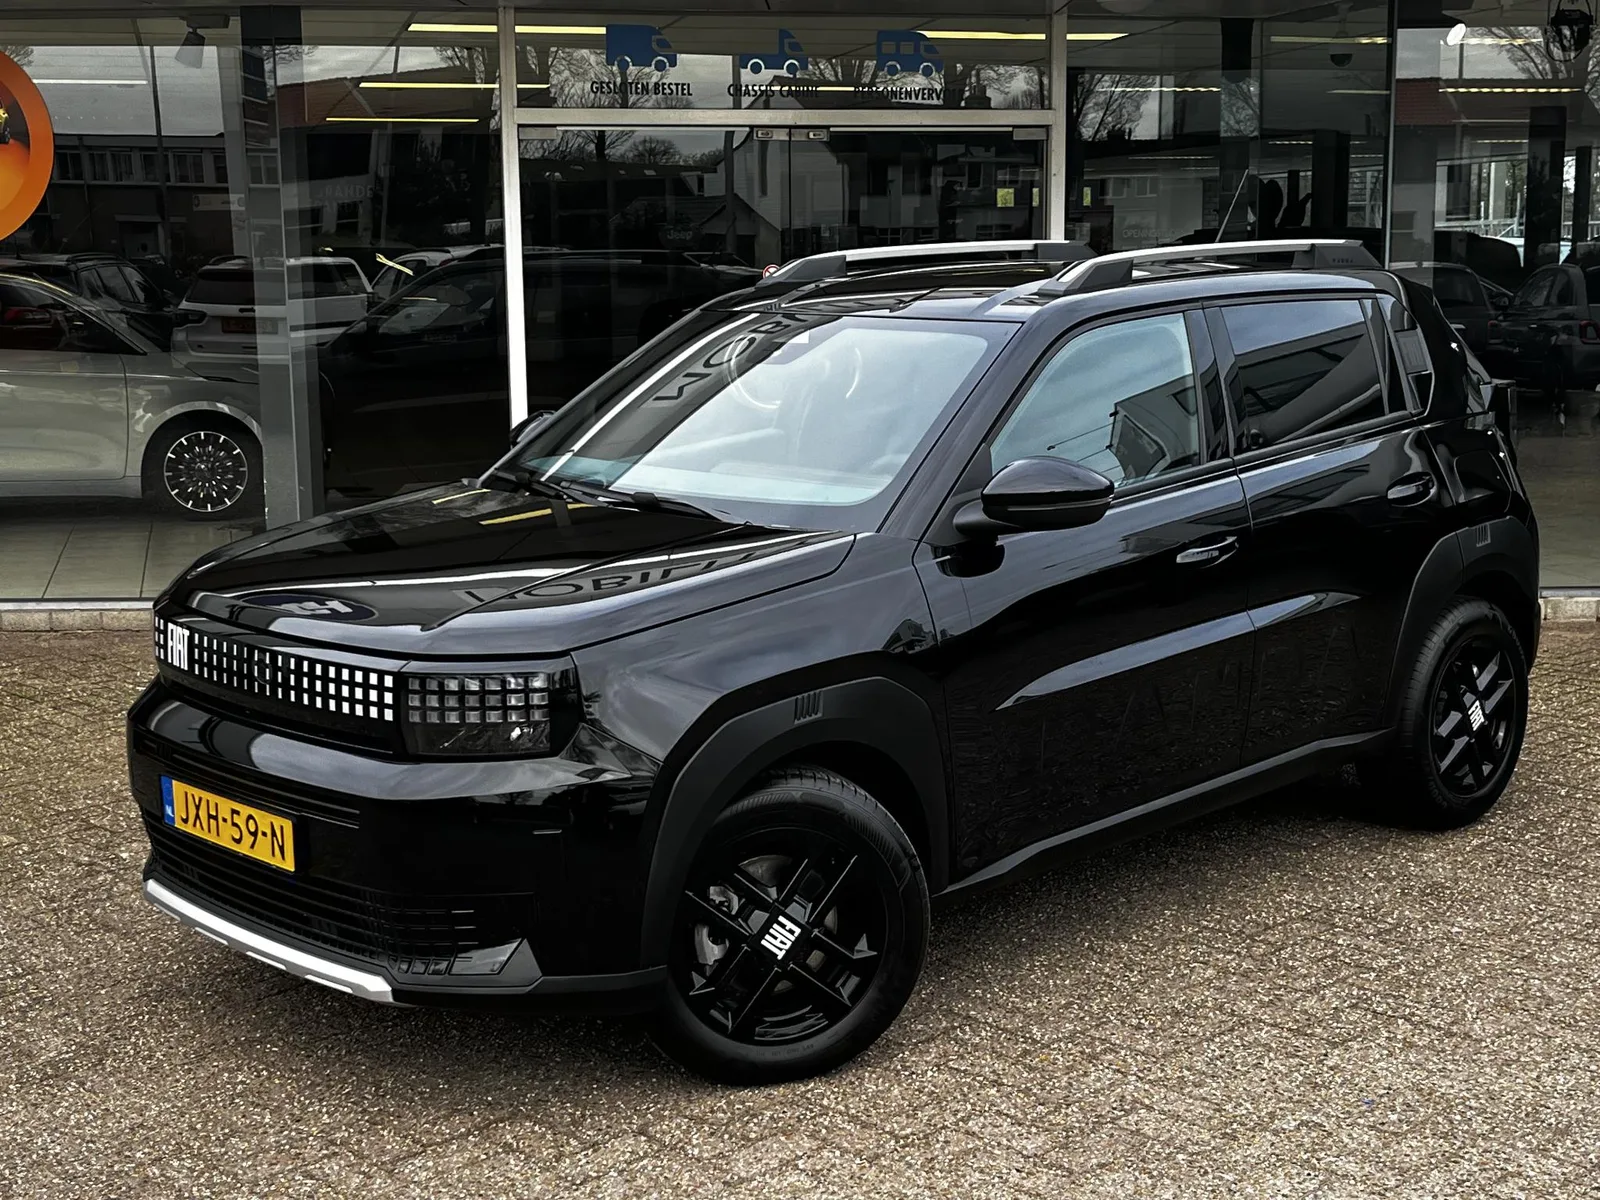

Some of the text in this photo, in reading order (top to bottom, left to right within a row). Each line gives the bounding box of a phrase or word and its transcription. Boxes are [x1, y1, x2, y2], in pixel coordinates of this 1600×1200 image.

[590, 80, 693, 97] GESLOTEN BESTEL
[727, 83, 775, 98] CHASSIS
[854, 85, 965, 101] PERSONENVERVO
[168, 622, 190, 671] FIAT
[1467, 700, 1485, 732] FIAT
[165, 804, 175, 818] NL
[180, 790, 286, 862] JXH-59-N
[760, 915, 802, 960] FIAT
